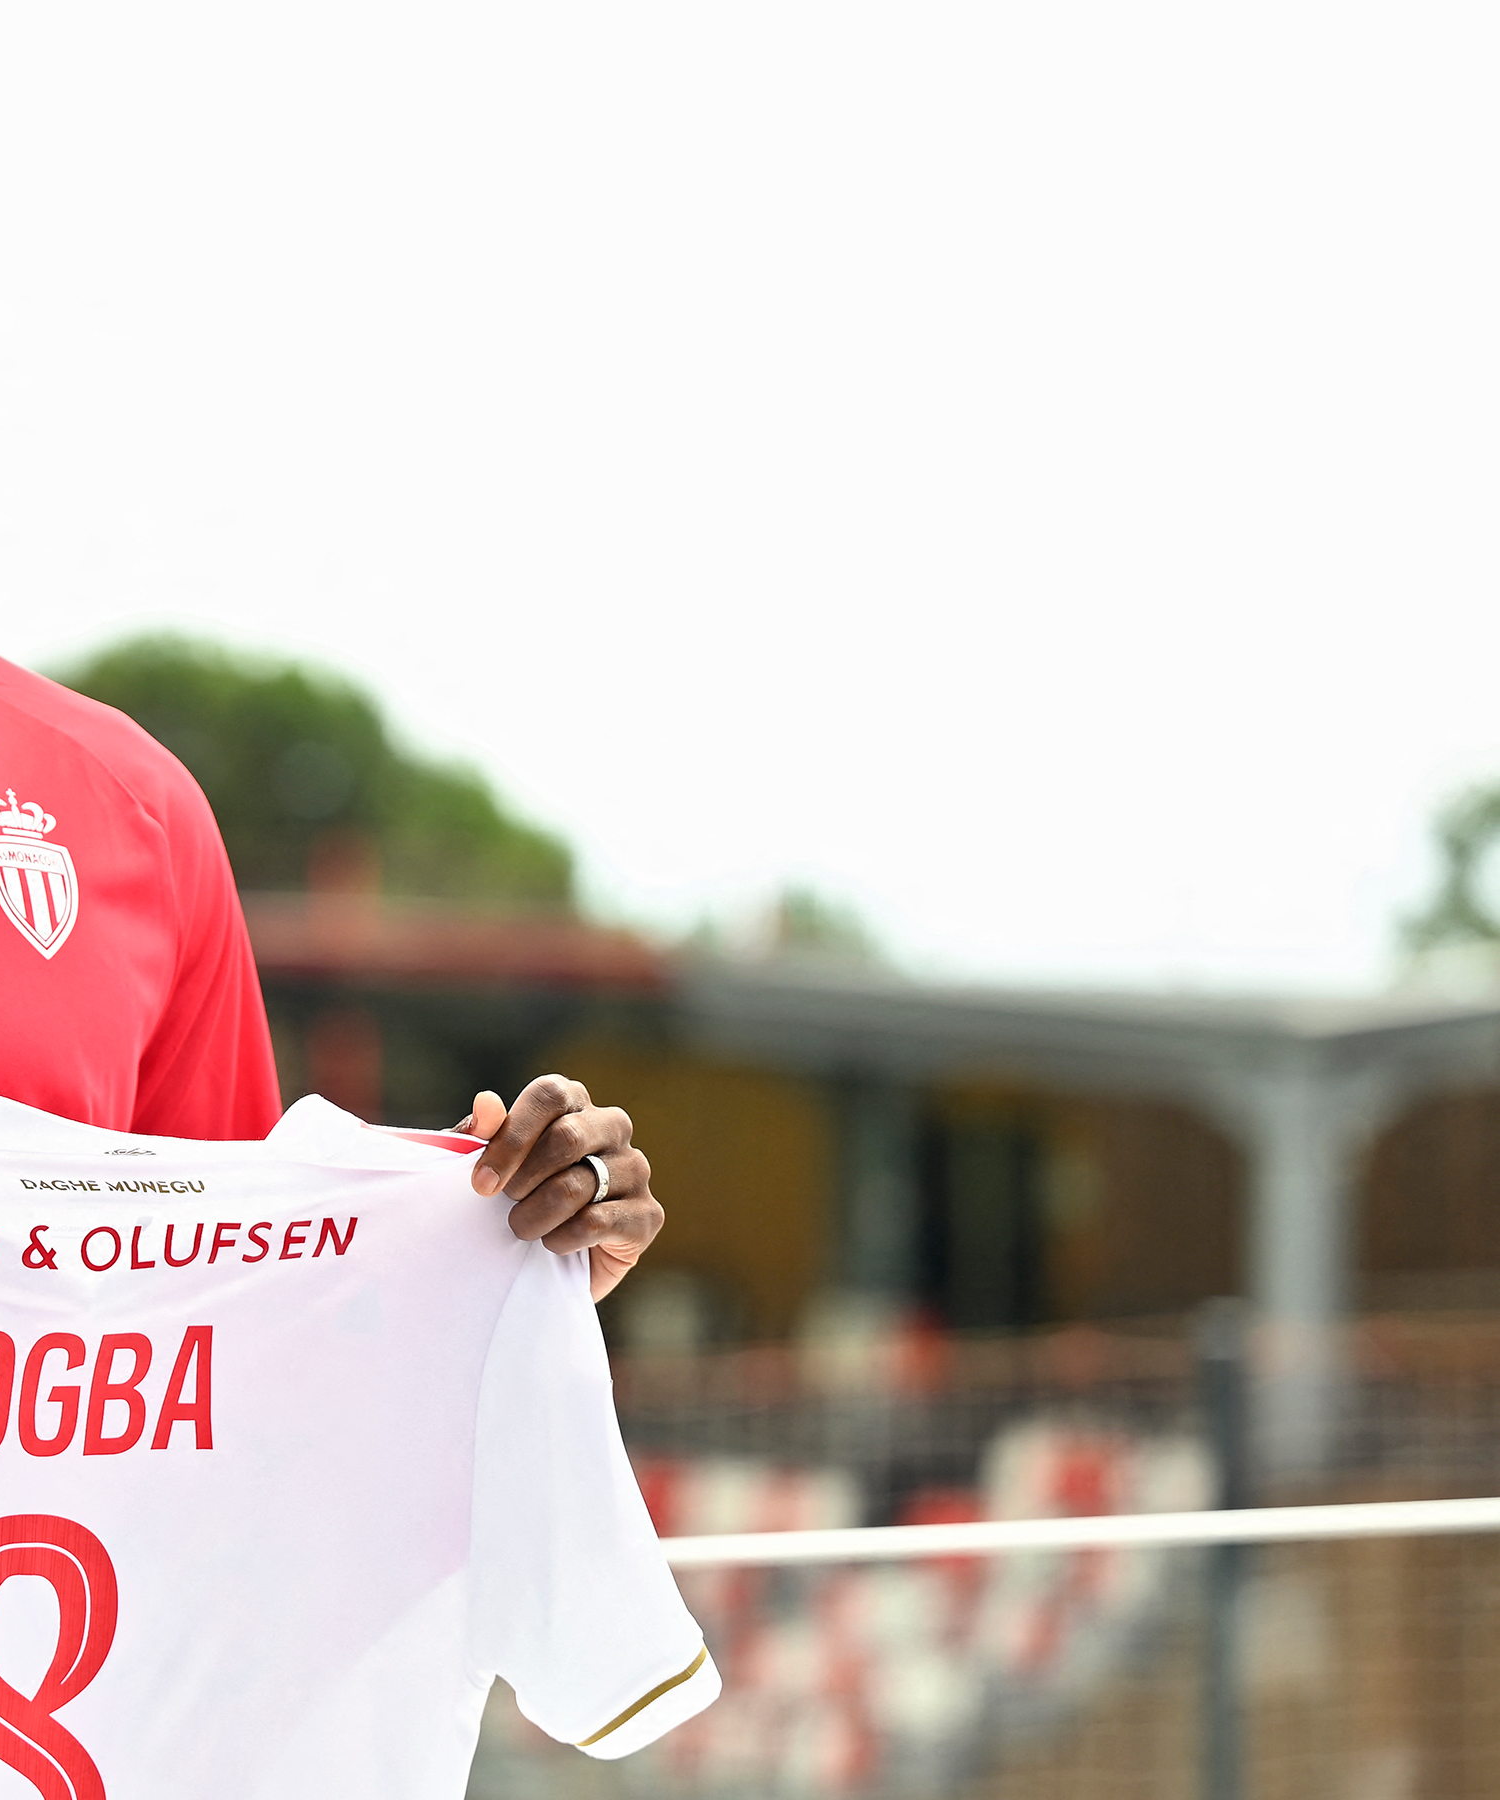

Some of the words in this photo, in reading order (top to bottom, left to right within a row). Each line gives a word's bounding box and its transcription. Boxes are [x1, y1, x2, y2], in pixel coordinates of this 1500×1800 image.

[8, 850, 52, 866] MONACO
[20, 1178, 101, 1192] DAGHE
[105, 1180, 206, 1194] MUNEGU
[21, 1224, 59, 1271] &
[80, 1216, 359, 1272] OLUFSEN
